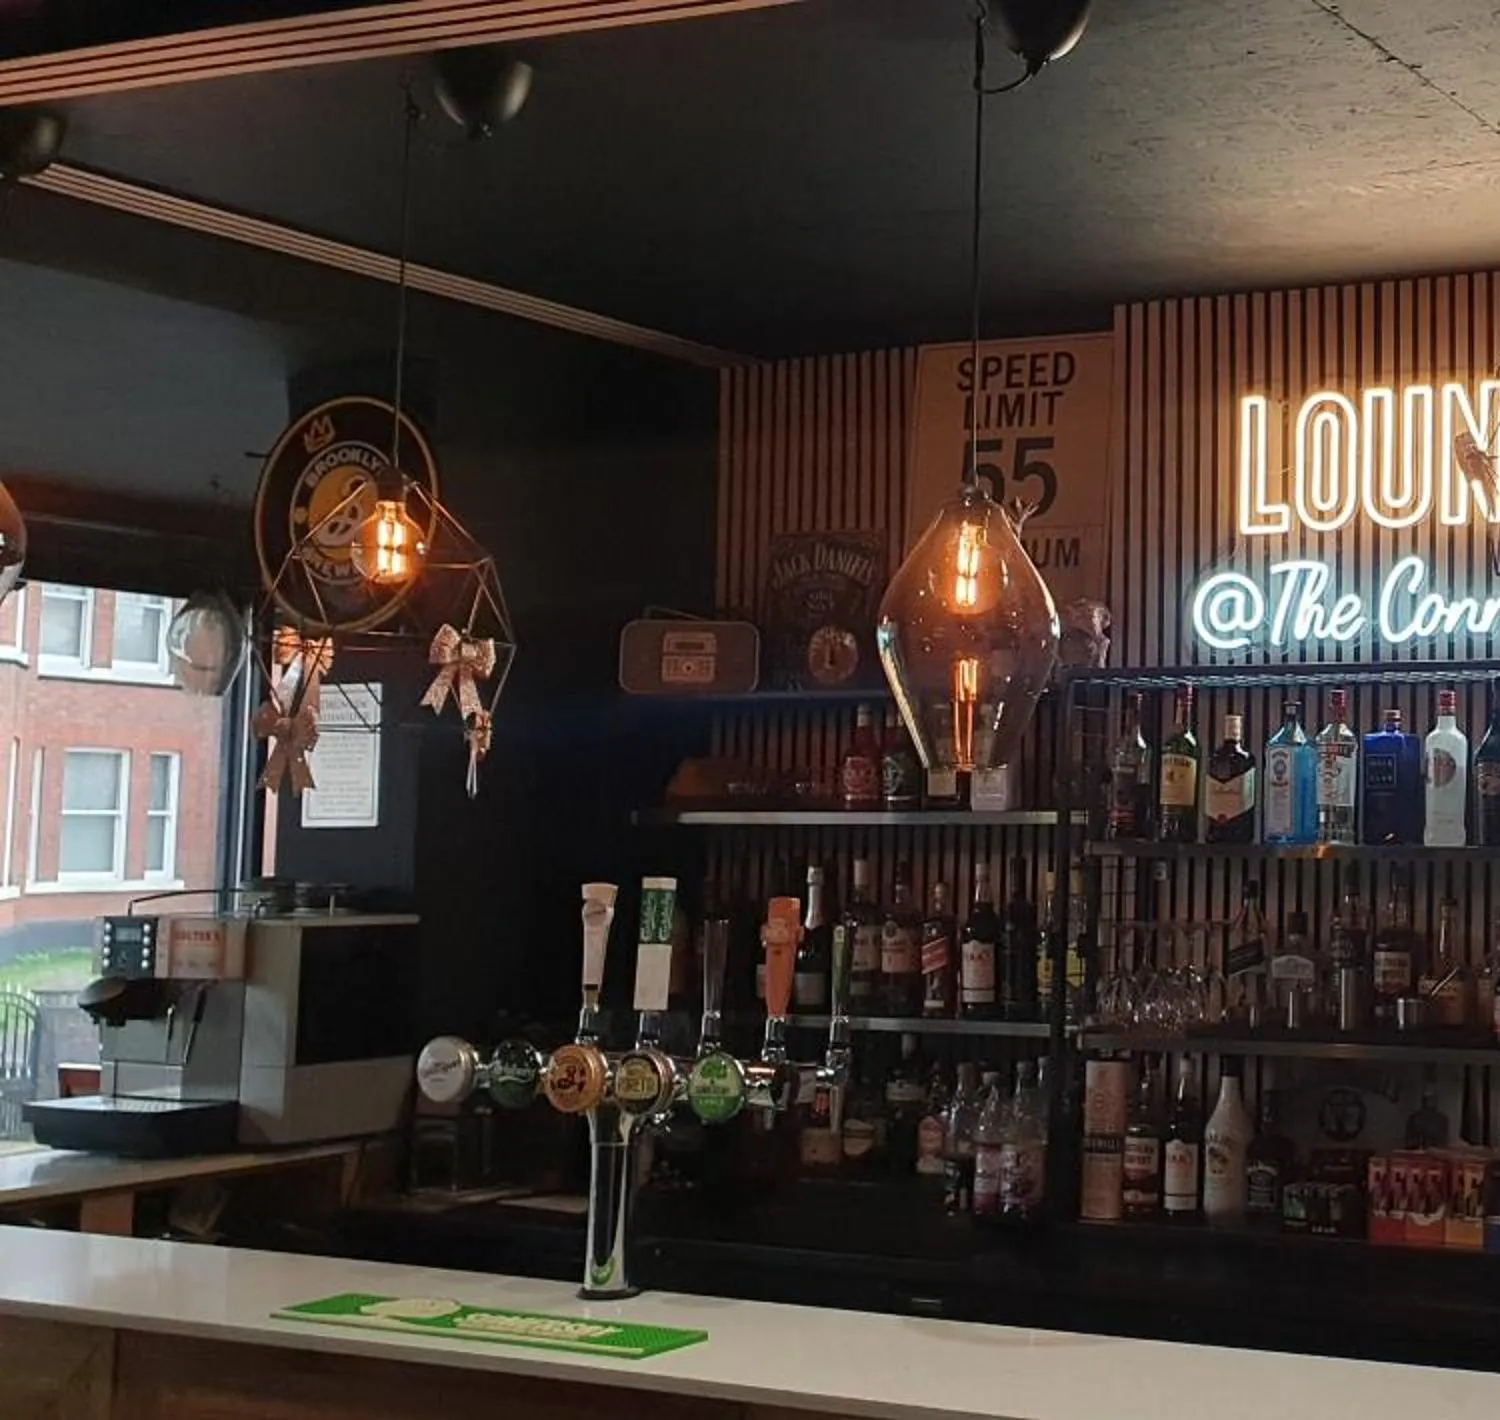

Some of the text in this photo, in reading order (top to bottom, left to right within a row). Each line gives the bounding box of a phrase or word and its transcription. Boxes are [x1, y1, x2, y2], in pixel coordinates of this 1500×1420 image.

[957, 351, 1076, 392] SPEED
[964, 391, 1064, 431] LIMIT
[960, 437, 1058, 520] 55
